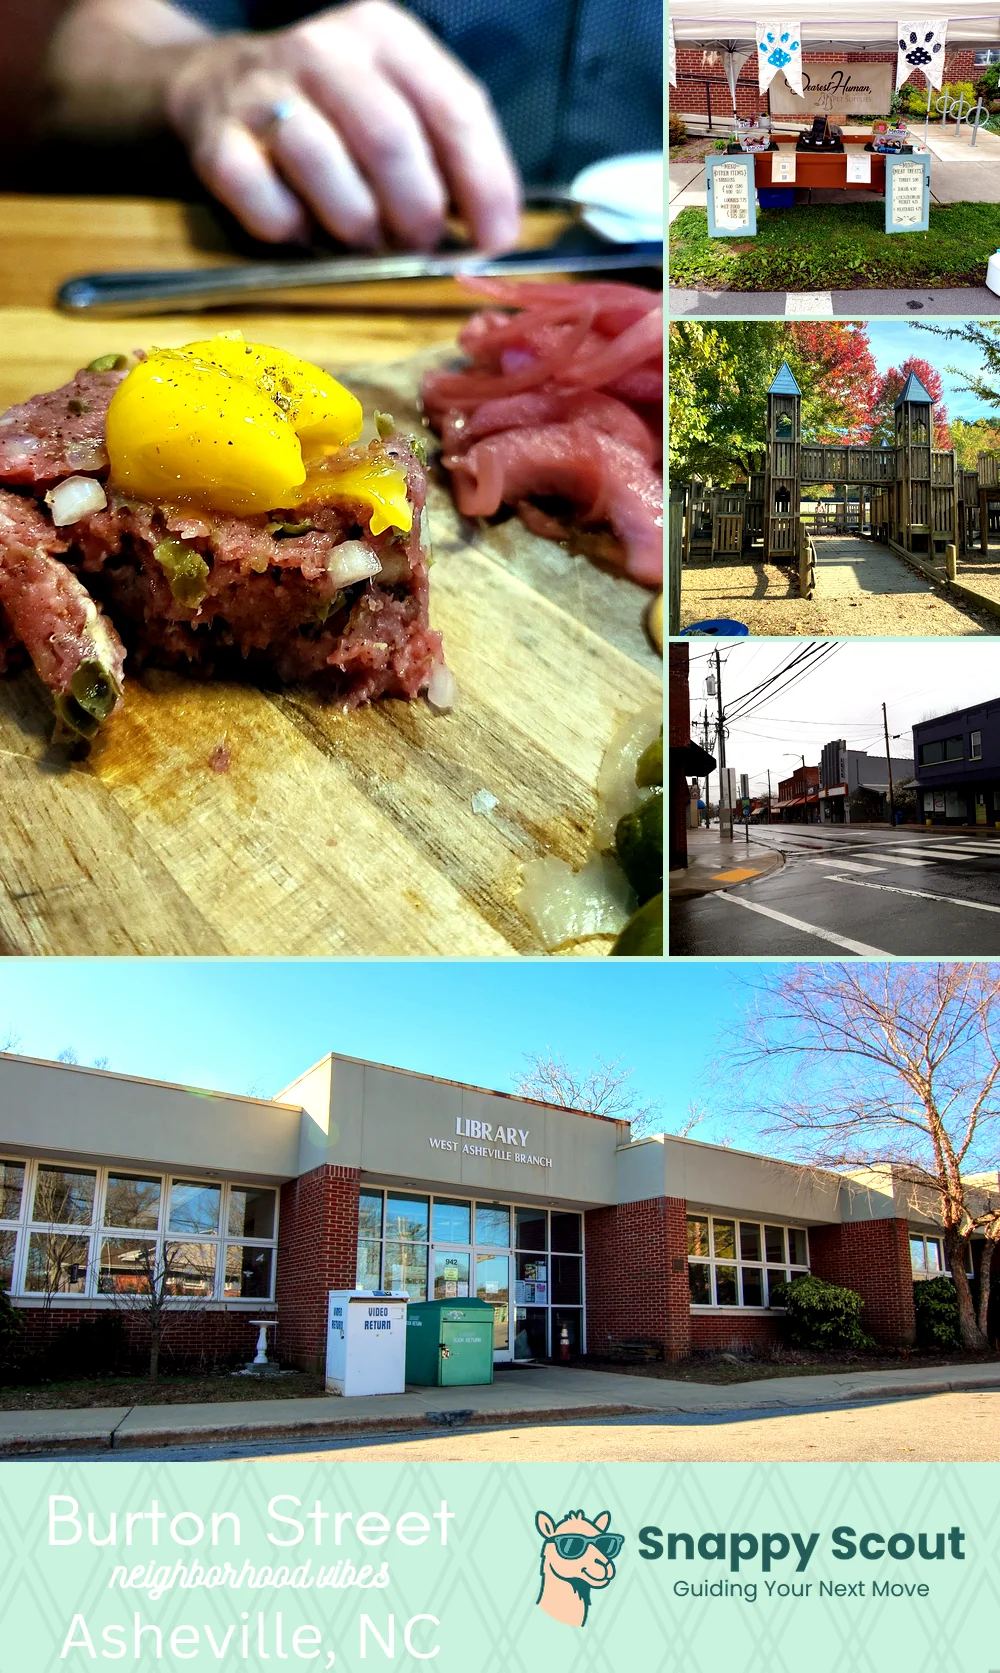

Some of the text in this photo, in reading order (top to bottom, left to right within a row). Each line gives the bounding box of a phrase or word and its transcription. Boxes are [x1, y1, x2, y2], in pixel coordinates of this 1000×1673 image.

[831, 70, 872, 95] Human,
[455, 1116, 529, 1147] LIBRARY
[429, 1137, 553, 1168] WEST ASHEVILLE BRANCH
[445, 1258, 458, 1266] 942
[368, 1307, 389, 1317] VIDEO
[364, 1320, 391, 1330] RETURN
